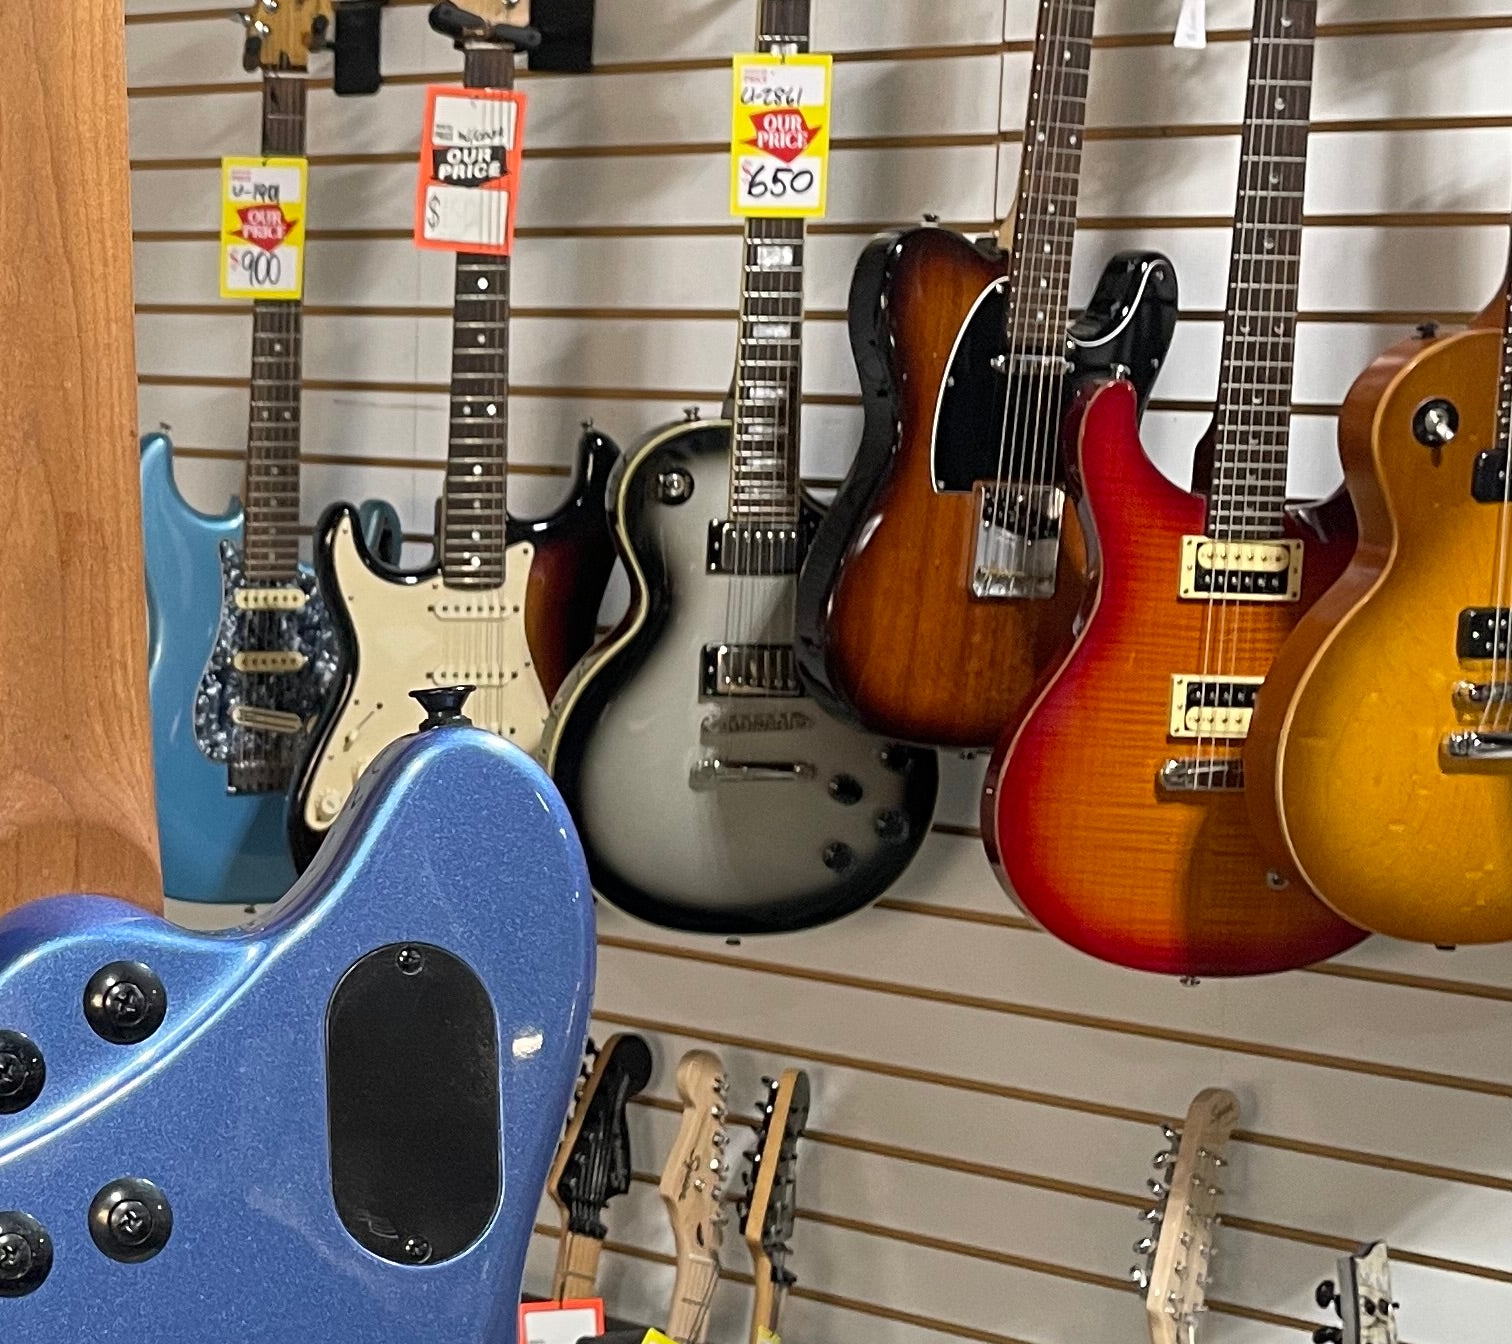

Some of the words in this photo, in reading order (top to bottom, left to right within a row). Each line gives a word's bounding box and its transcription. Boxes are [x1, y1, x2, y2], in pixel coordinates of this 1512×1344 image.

[762, 112, 803, 133] OUR
[756, 130, 810, 151] PRICE
[446, 146, 493, 165] OUR
[438, 160, 502, 182] PRICE
[247, 207, 283, 226] OUR
[242, 223, 288, 240] PRICE
